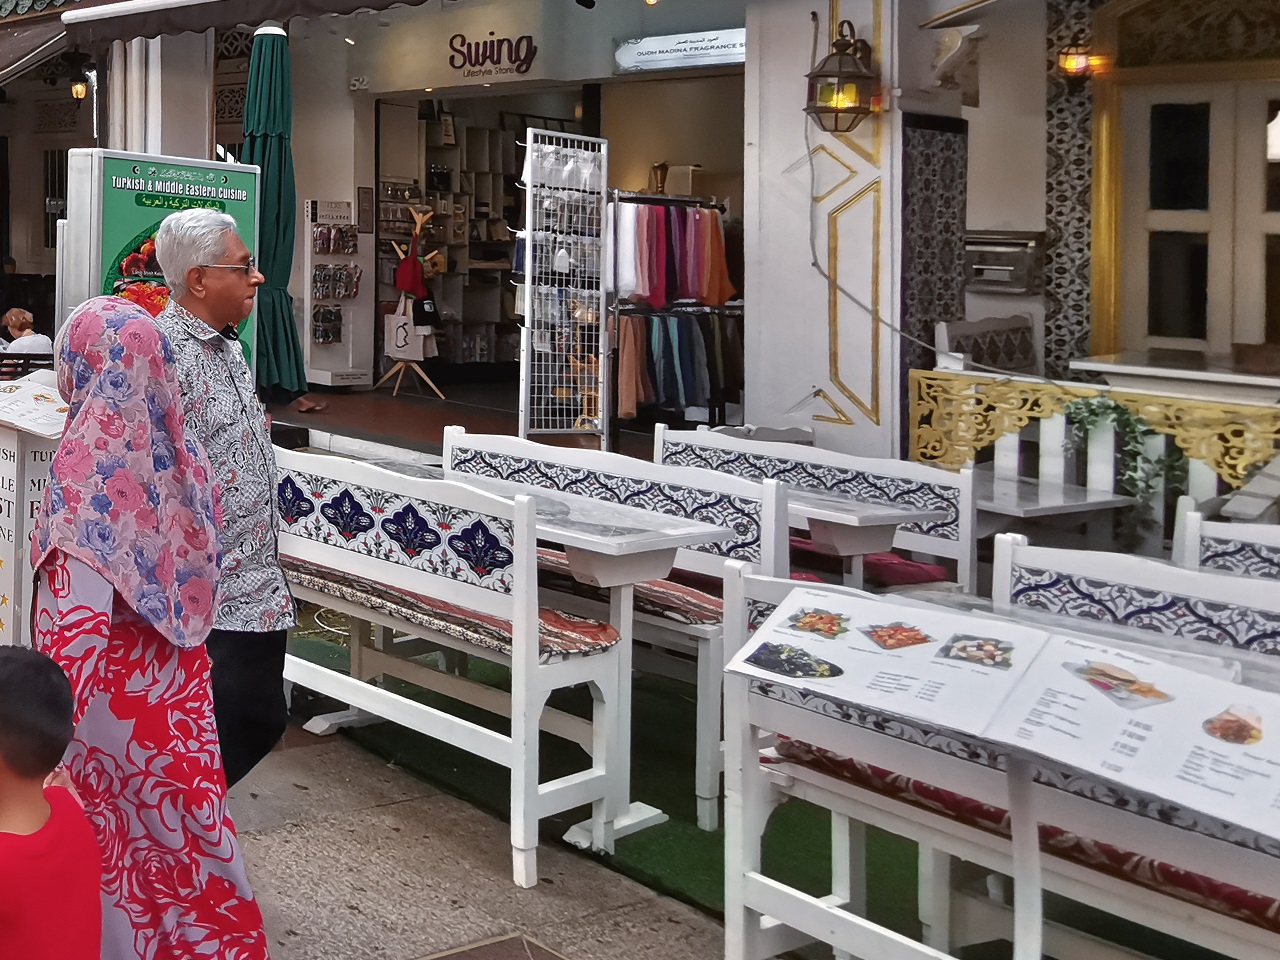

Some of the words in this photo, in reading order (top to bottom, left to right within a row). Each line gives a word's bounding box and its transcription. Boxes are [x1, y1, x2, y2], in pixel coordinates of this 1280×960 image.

[449, 31, 538, 74] Swing
[689, 43, 737, 52] FRAGRANCE
[463, 69, 493, 78] Lifestyle
[495, 67, 515, 75] Store
[350, 76, 369, 90] 52
[112, 176, 145, 191] Turkish
[148, 182, 153, 192] &
[155, 181, 184, 194] Middle
[186, 184, 217, 198] Eastern
